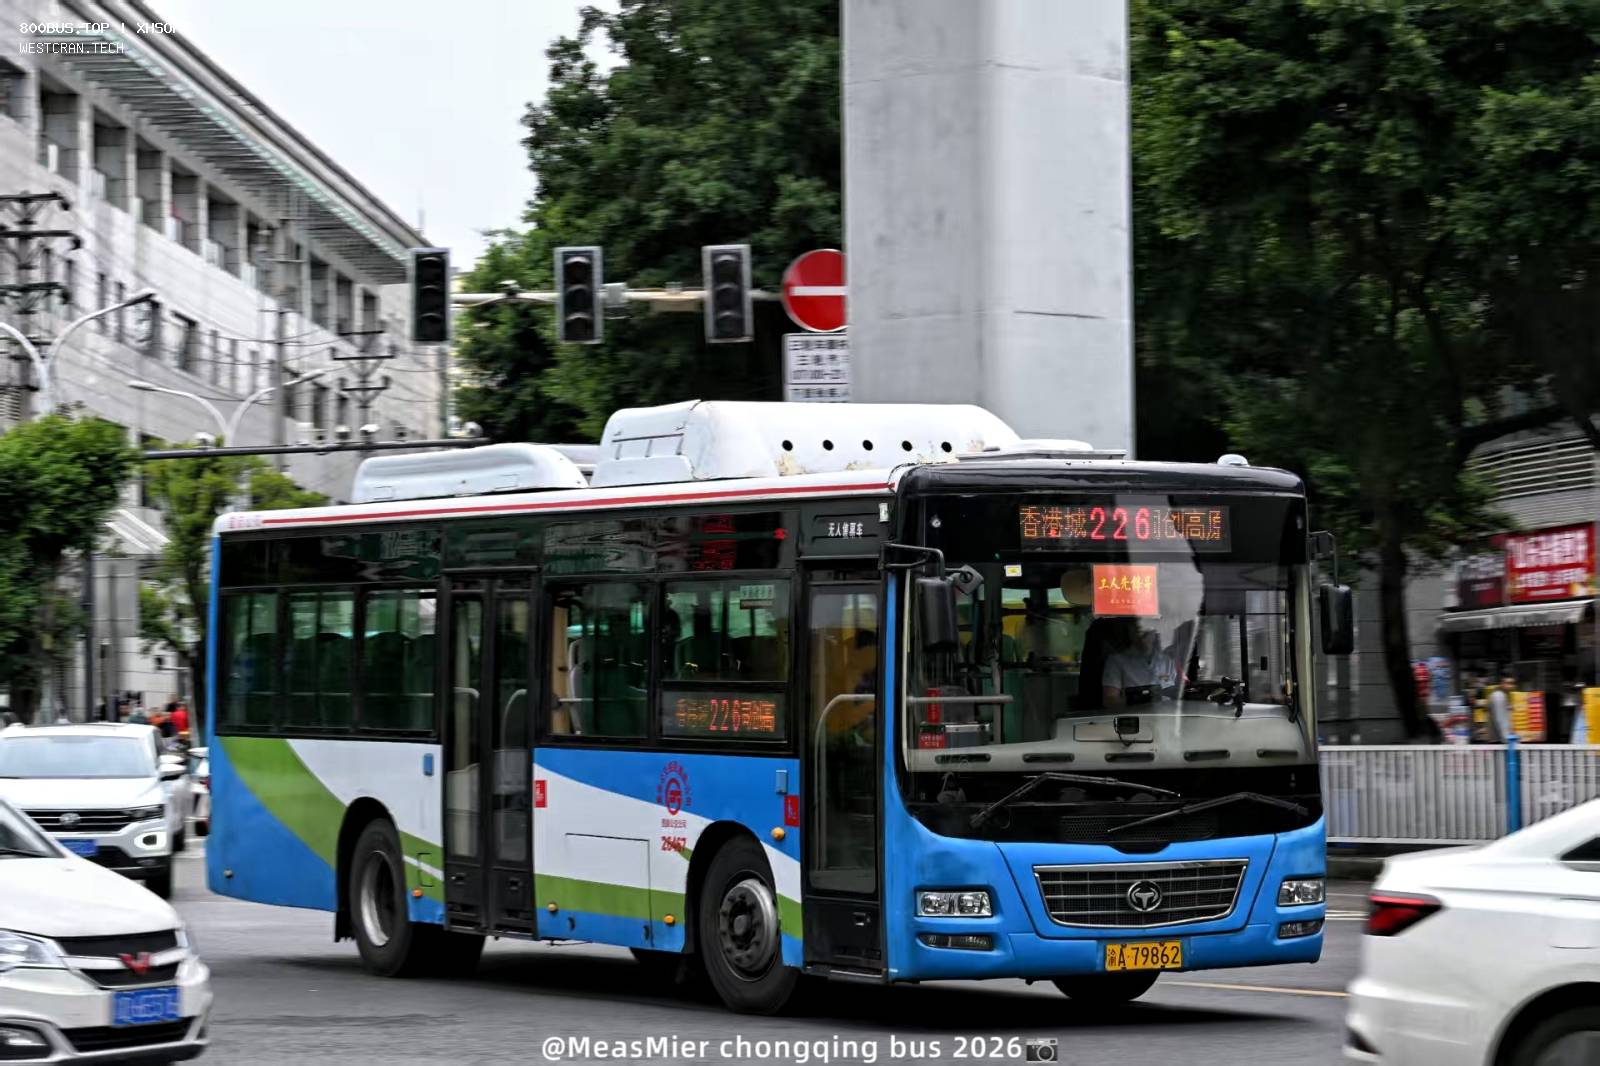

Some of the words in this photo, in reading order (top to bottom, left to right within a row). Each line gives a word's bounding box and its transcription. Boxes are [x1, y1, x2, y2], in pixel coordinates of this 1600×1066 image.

[827, 521, 864, 538] 无人售票车
